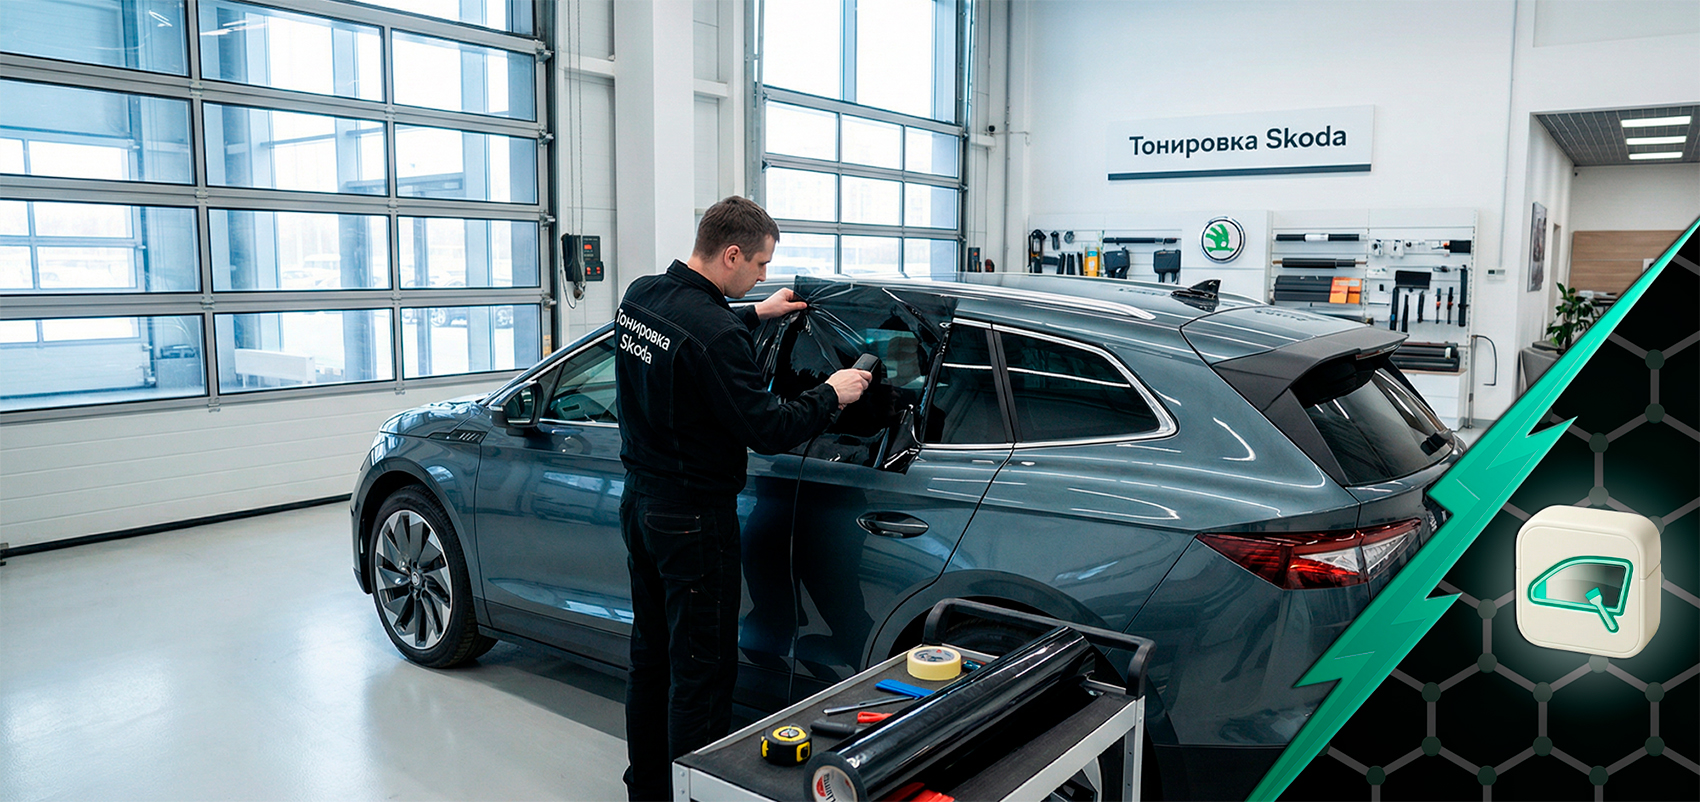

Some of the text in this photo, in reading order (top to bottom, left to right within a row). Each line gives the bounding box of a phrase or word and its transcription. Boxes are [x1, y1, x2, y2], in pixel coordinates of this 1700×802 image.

[1129, 125, 1347, 159] Тонировка Skoda
[616, 308, 671, 351] Тонировка
[620, 333, 653, 364] Skoda
